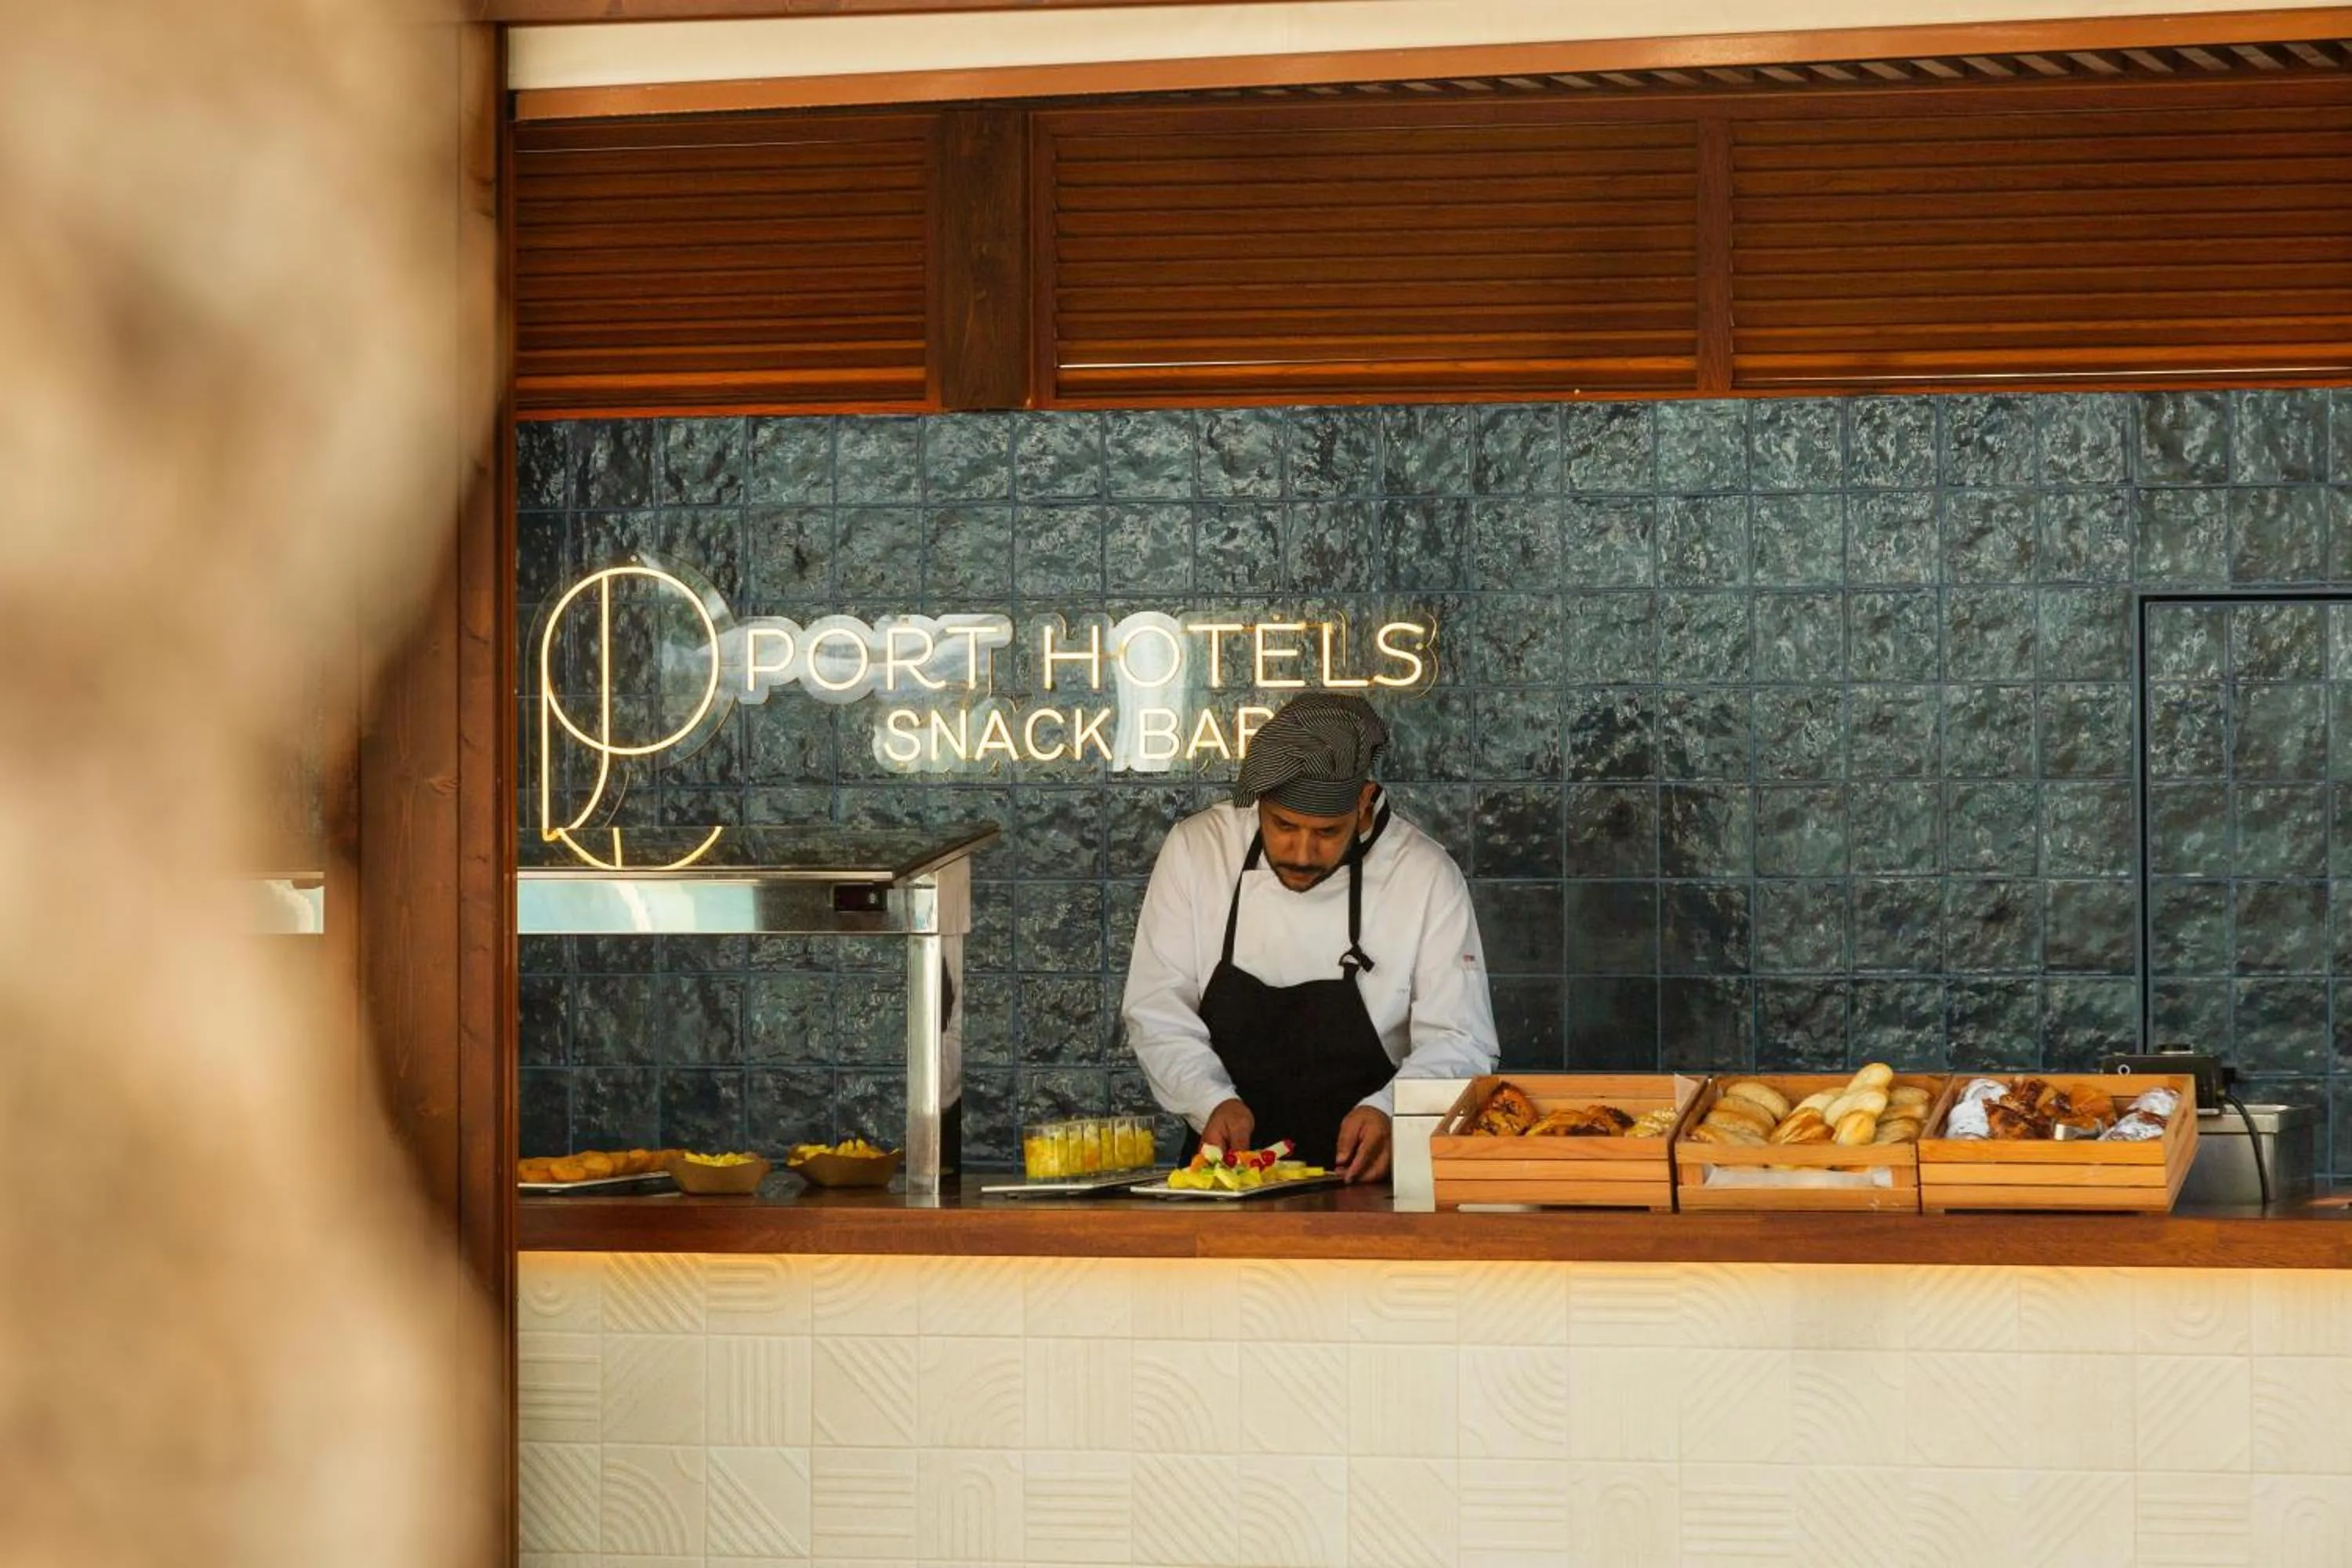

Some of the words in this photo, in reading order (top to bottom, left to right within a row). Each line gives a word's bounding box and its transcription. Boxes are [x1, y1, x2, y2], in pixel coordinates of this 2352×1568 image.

[747, 626, 998, 691] PORT
[1044, 622, 1425, 688] HOTELS
[884, 708, 1113, 761] SNACK
